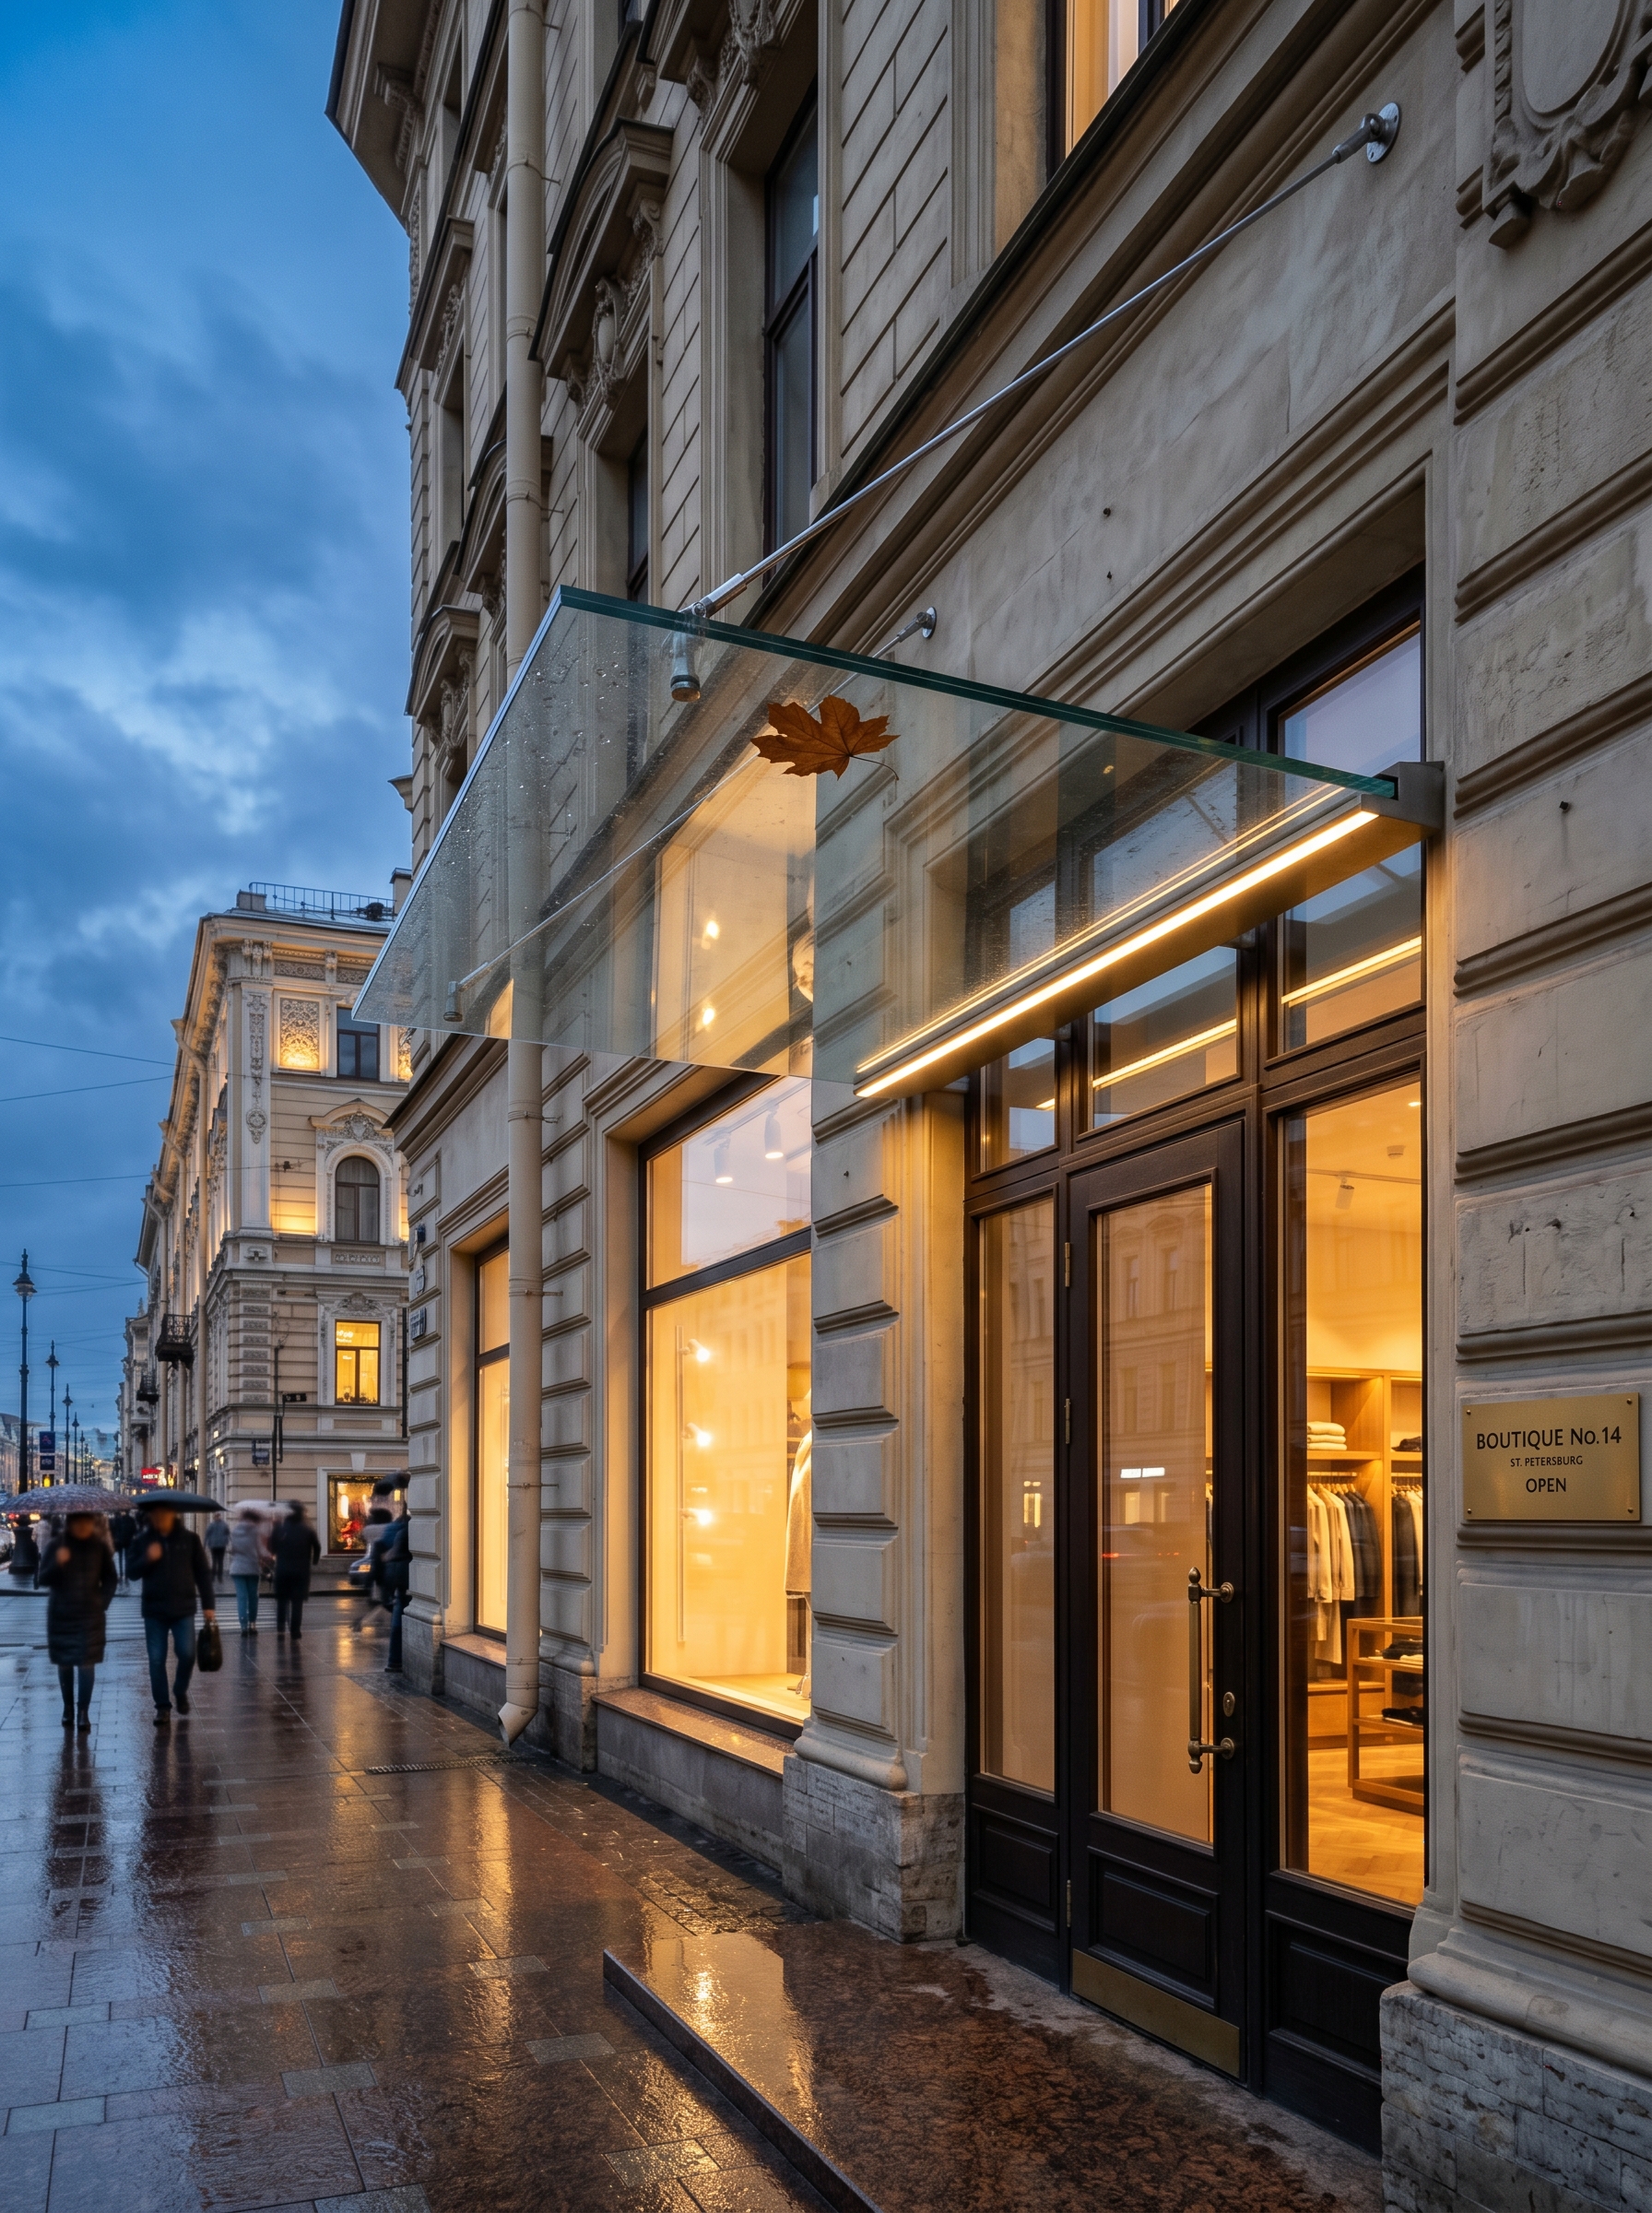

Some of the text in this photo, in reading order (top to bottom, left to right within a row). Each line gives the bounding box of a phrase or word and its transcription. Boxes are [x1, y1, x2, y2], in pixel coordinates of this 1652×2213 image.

[1476, 1426, 1622, 1450] BOUTIQUE No.14
[1510, 1455, 1584, 1468] ST. PETERSBURG
[1525, 1477, 1567, 1493] OPEN
